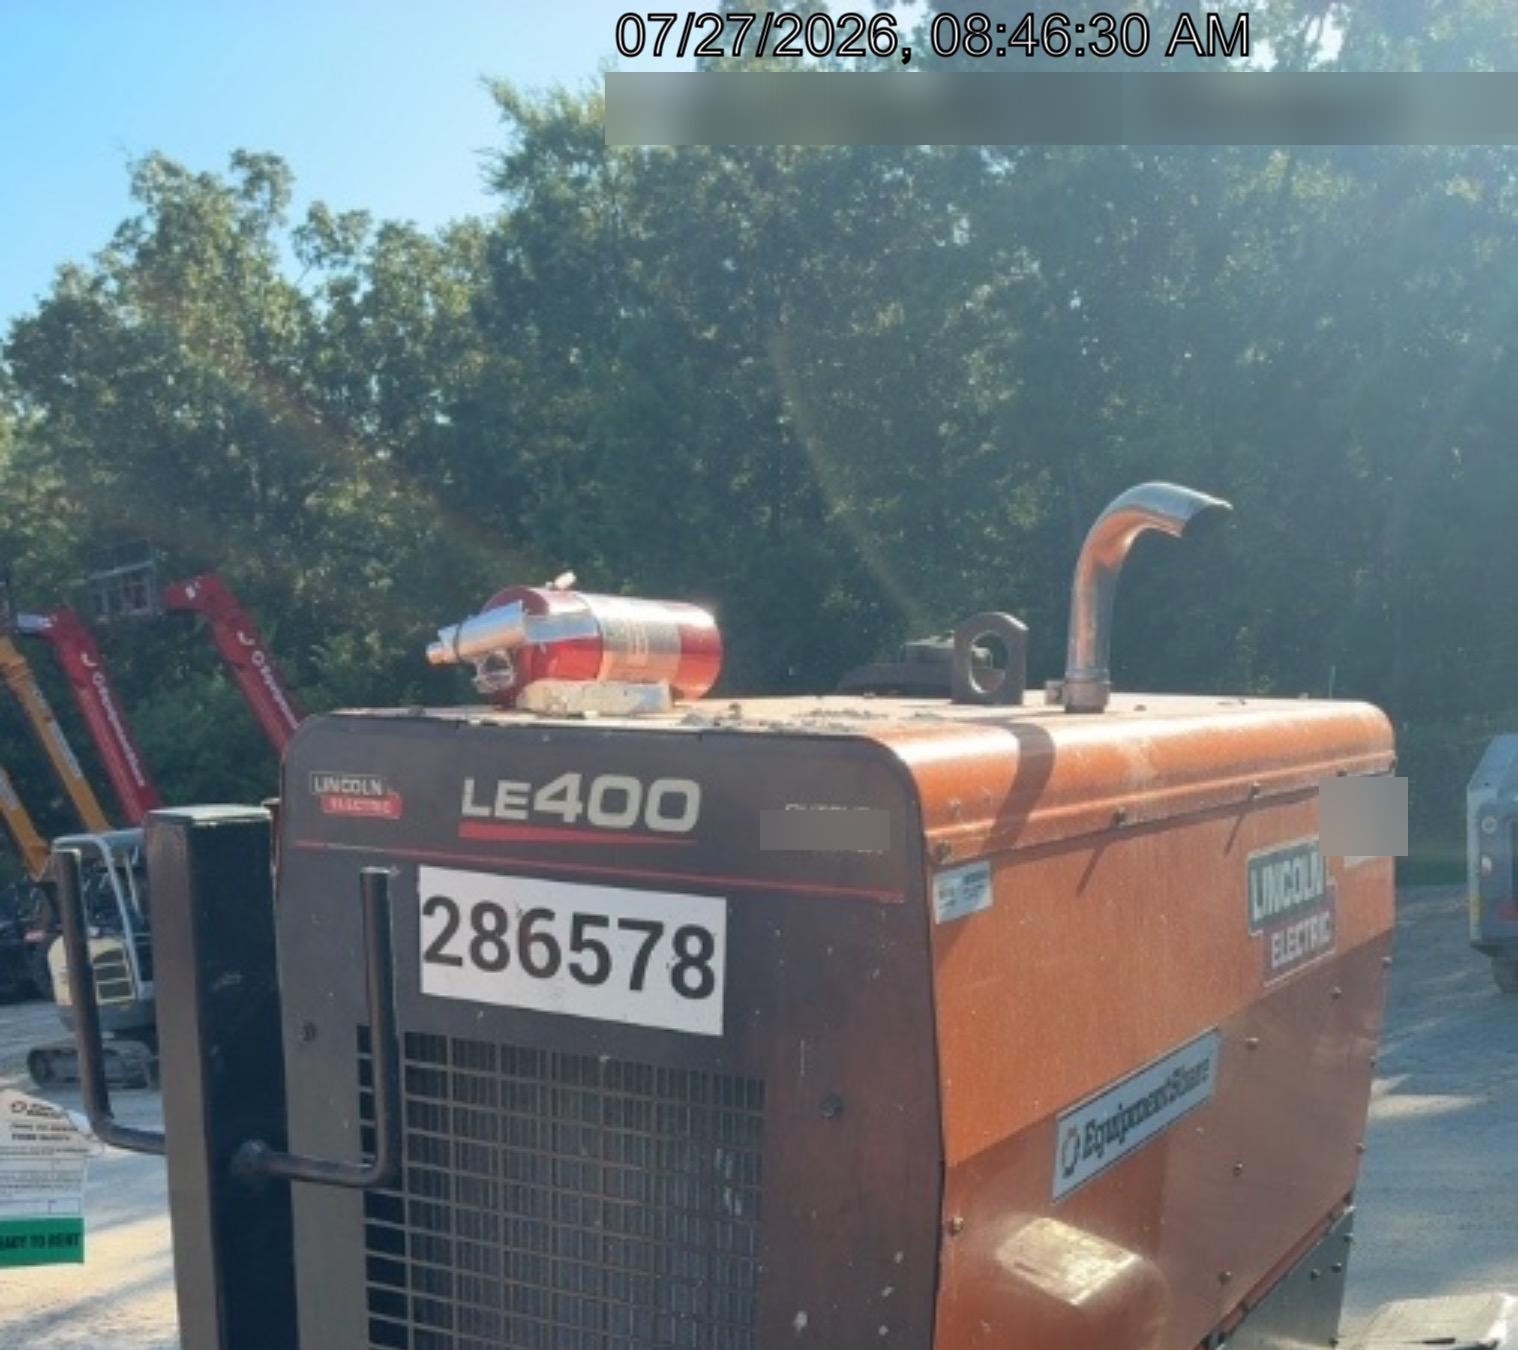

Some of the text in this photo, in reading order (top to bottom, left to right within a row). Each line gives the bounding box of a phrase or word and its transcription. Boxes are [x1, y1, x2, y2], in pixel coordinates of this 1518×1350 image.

[313, 775, 383, 797] LINCOLN
[461, 773, 701, 832] LE400
[1250, 848, 1325, 922] LINCOLN
[421, 894, 716, 1000] 286578
[1270, 911, 1332, 970] ELECTRIC
[1082, 1057, 1211, 1159] EquipmentShare
